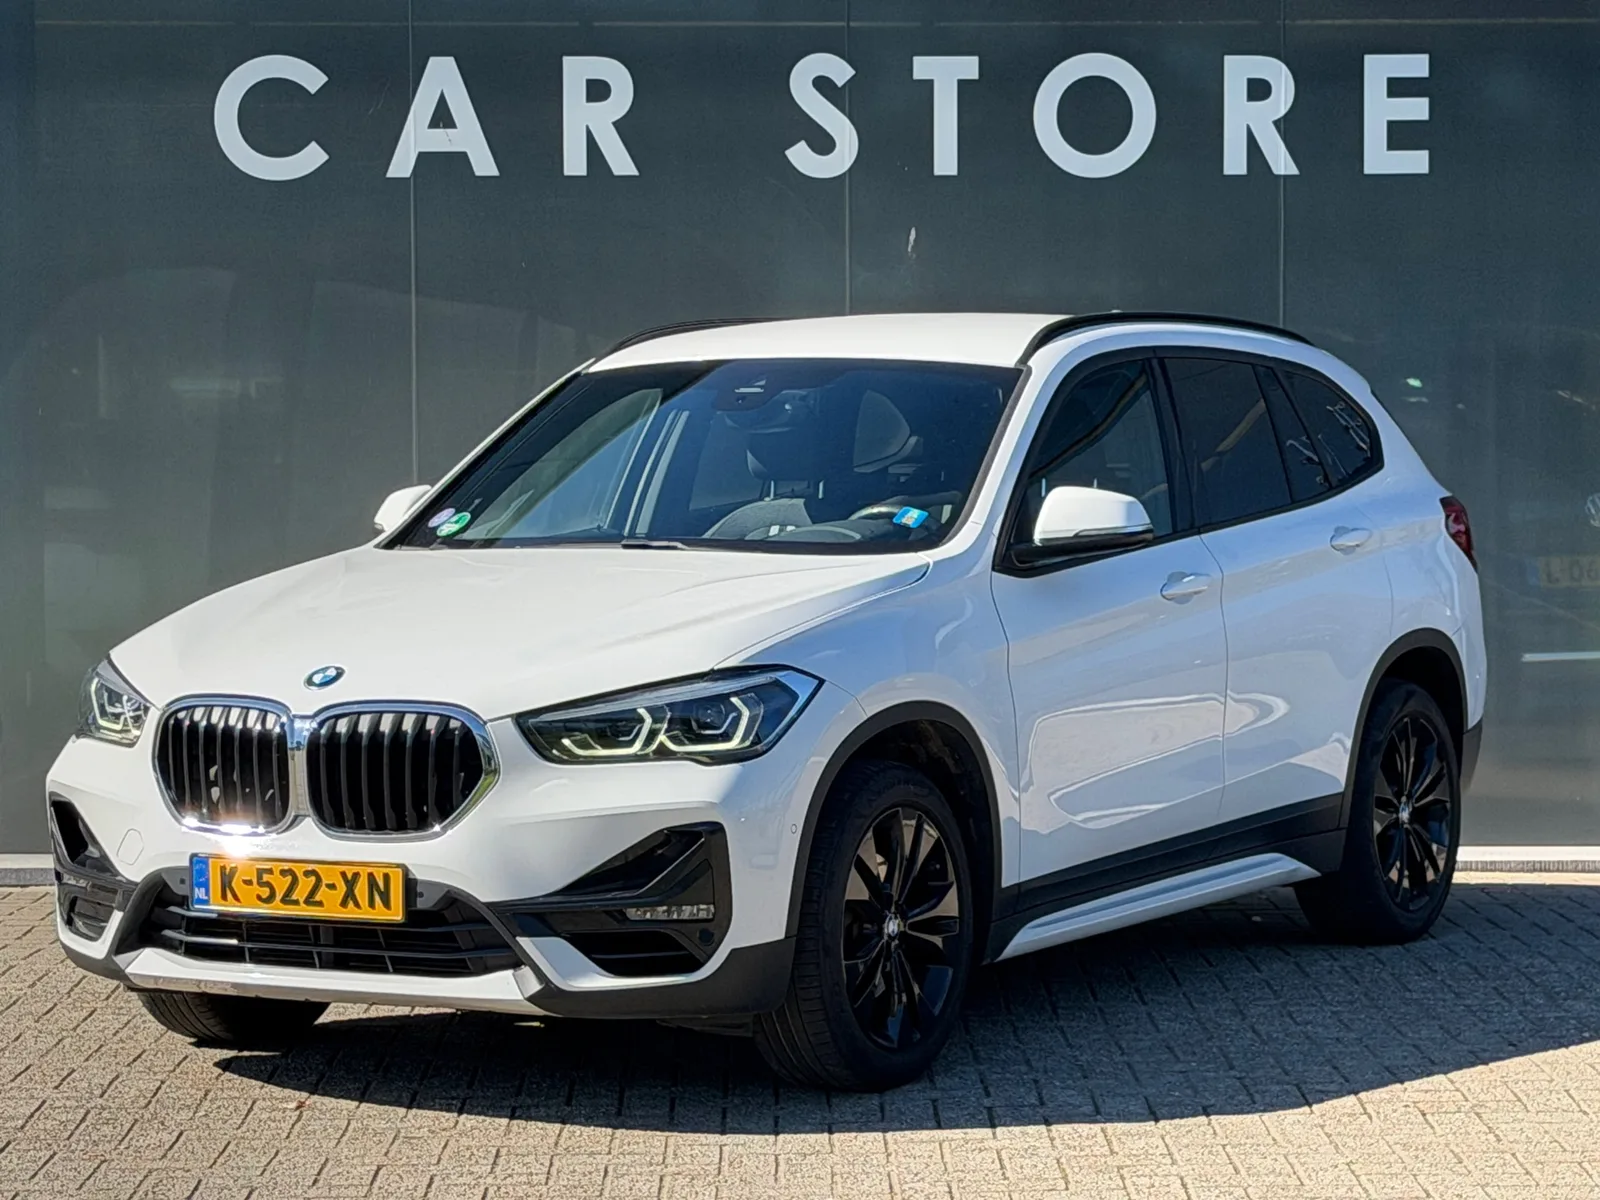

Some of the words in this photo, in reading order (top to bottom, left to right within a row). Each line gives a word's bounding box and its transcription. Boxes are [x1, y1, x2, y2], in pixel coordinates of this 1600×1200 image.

[214, 55, 638, 180] CAR
[786, 53, 1430, 178] STORE
[194, 887, 209, 900] NL
[219, 864, 392, 911] K-522-XN
